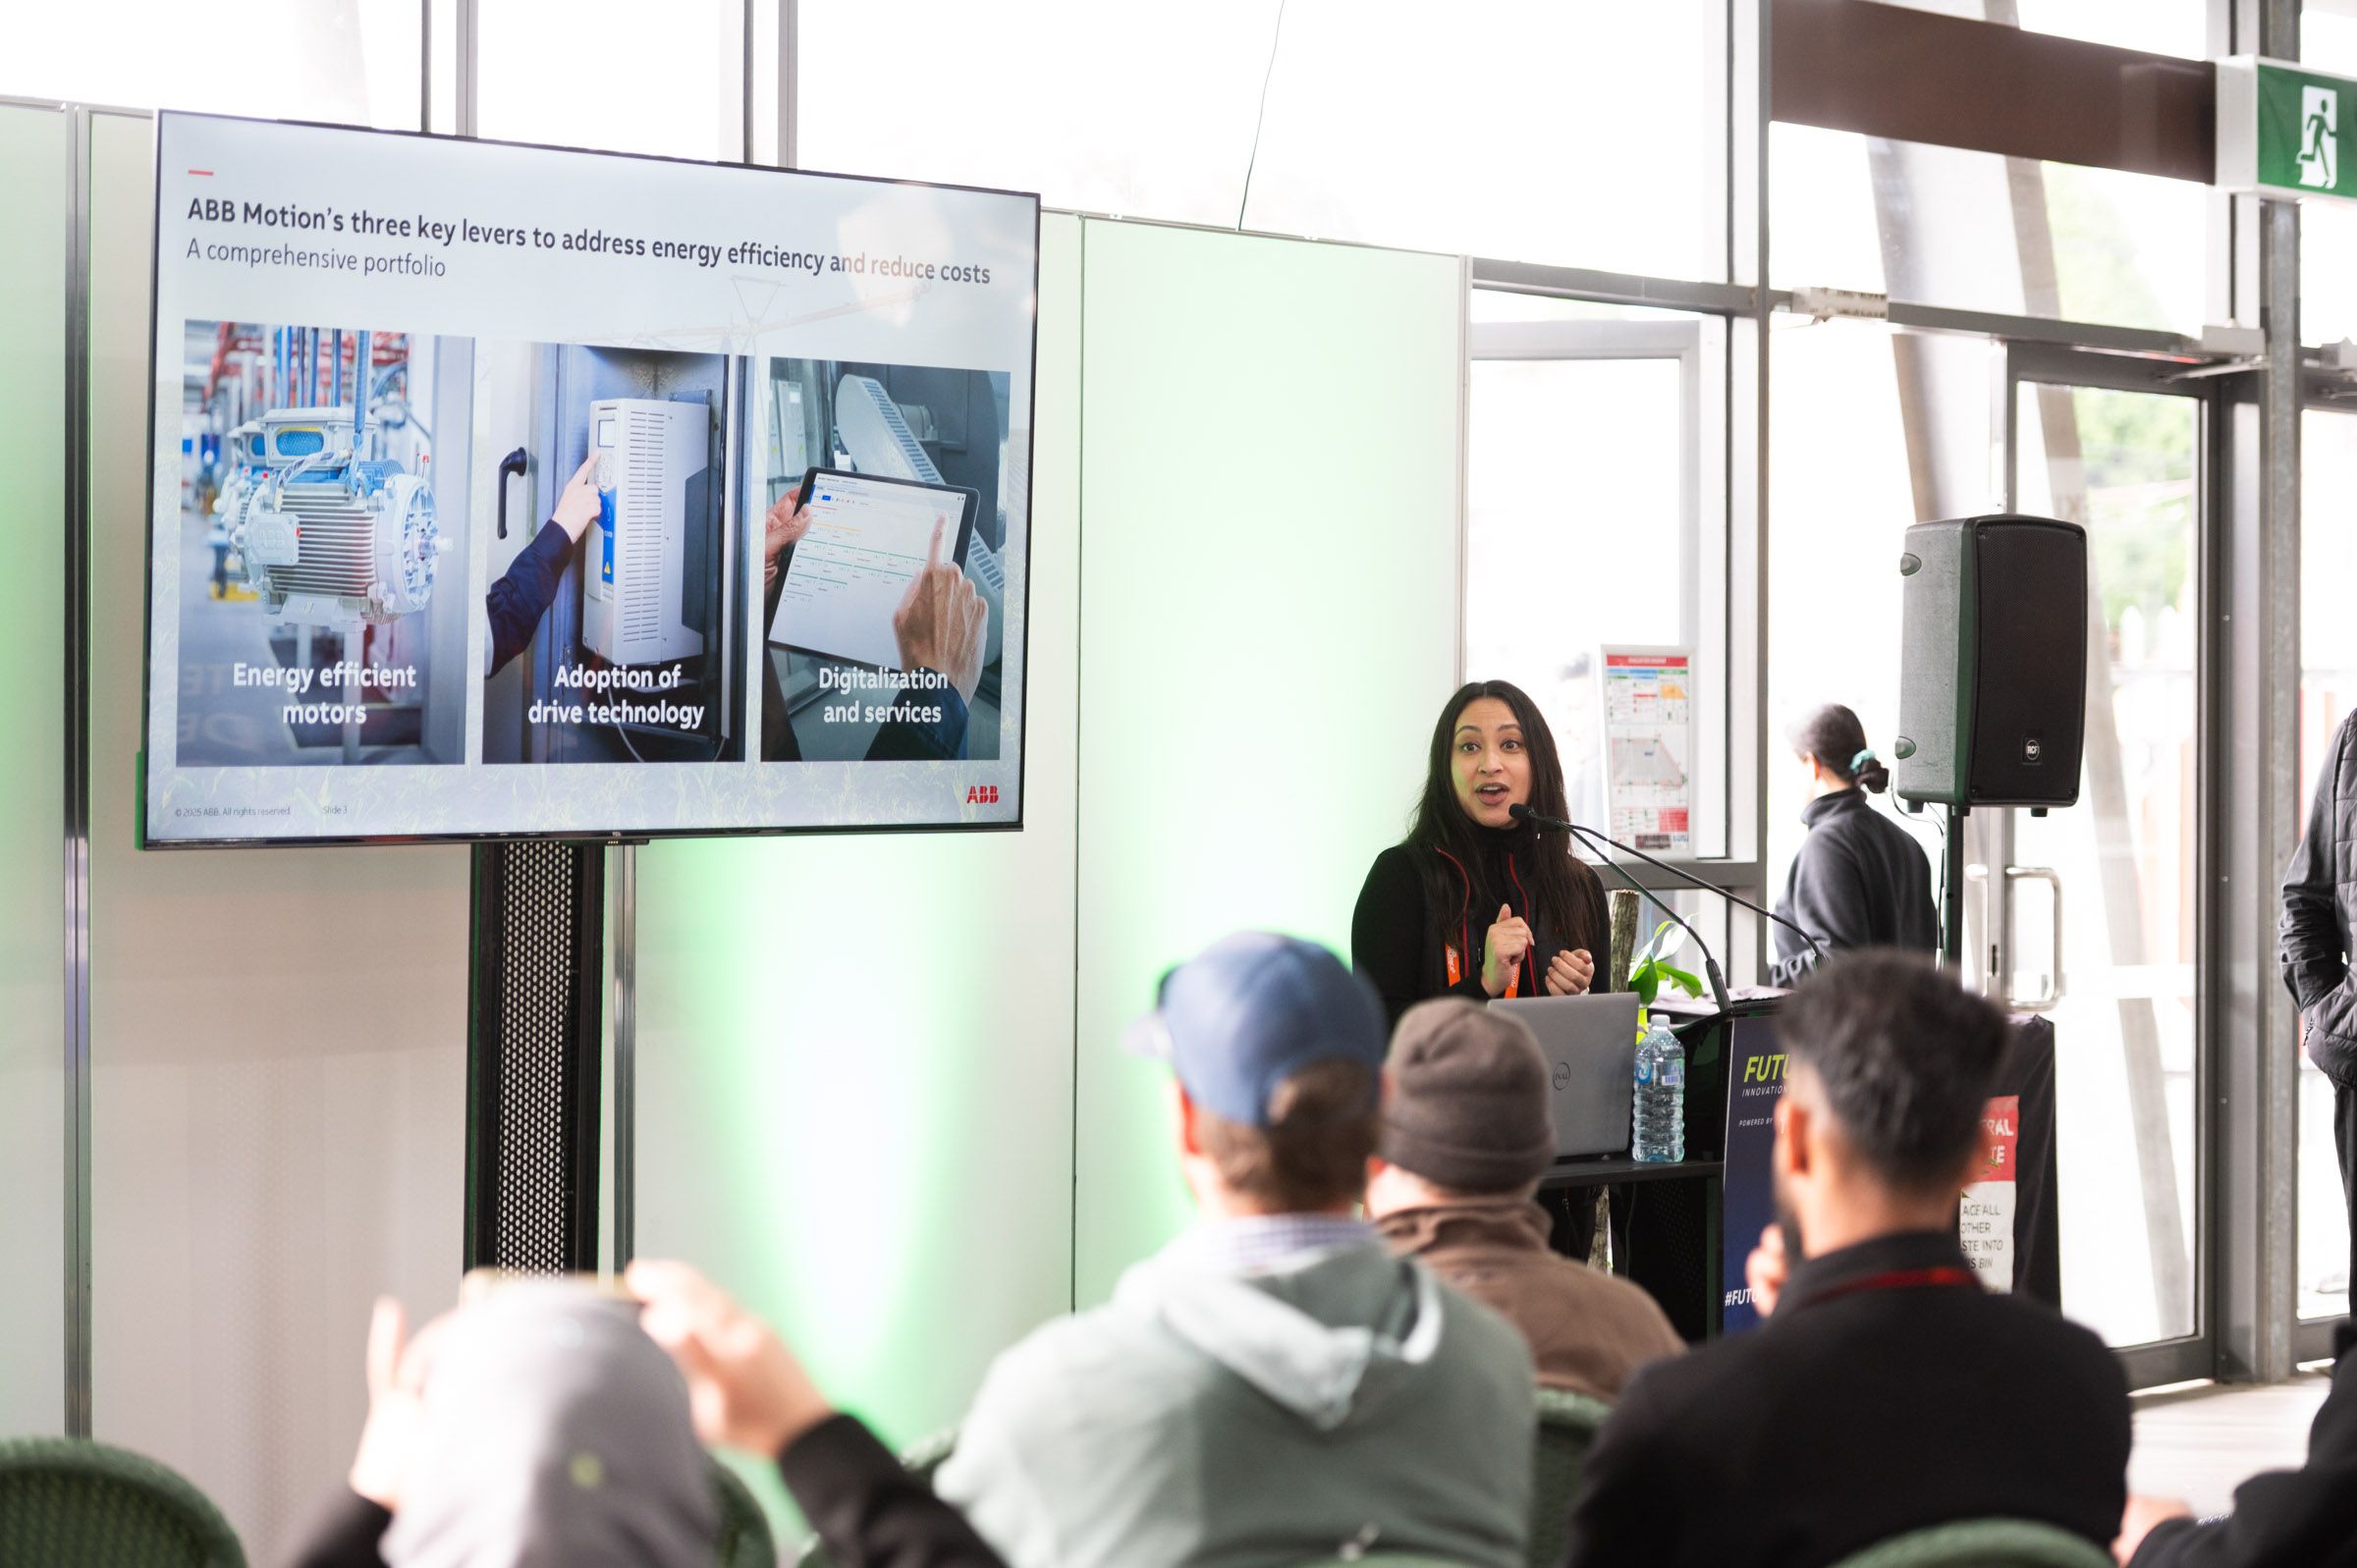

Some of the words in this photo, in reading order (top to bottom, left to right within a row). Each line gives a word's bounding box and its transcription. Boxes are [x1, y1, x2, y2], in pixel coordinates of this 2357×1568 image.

[188, 197, 236, 223] ABB
[351, 210, 411, 237] three
[417, 215, 456, 246] key
[463, 218, 525, 246] levers
[532, 226, 556, 248] to
[562, 227, 645, 256] address
[652, 242, 721, 267] energy
[728, 242, 824, 276] efficiency
[830, 252, 865, 274] and
[871, 253, 935, 280] reduce
[941, 262, 991, 285] costs
[186, 238, 200, 259] A
[207, 243, 357, 270] comprehensive
[364, 252, 446, 277] portfolio
[234, 663, 314, 693] Energy
[320, 663, 415, 687] efficient
[554, 664, 653, 693] Adoption
[659, 664, 682, 688] of
[819, 667, 948, 694] Digitalization
[282, 702, 367, 724] motors
[528, 700, 581, 724] drive
[588, 700, 704, 729] technology
[824, 701, 858, 723] and
[864, 700, 942, 723] services
[966, 785, 999, 804] ABB
[233, 807, 256, 817] rights
[323, 805, 342, 815] Slide
[1738, 1117, 1765, 1127] POWERED
[1982, 1239, 2003, 1252] INTO
